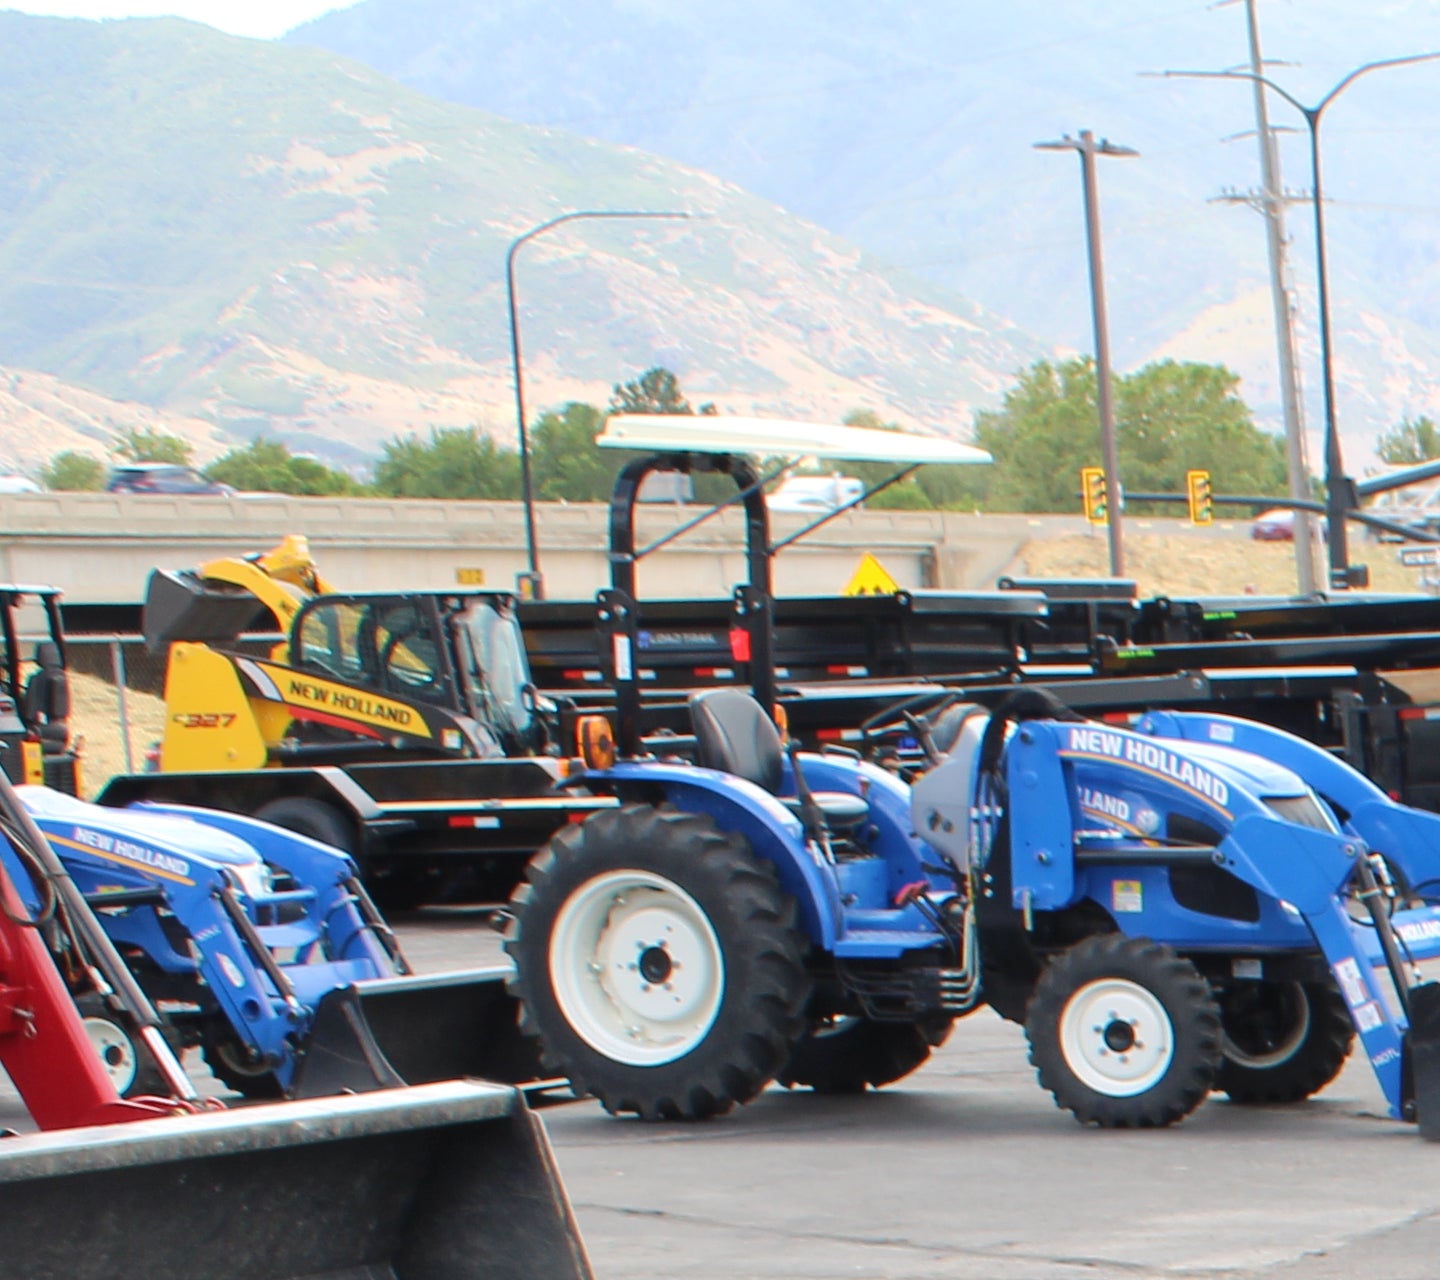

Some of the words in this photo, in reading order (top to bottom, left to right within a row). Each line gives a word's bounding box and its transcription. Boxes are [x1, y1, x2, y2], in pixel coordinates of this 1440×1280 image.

[289, 680, 331, 704] NEW
[331, 692, 411, 726] HOLLAND
[1070, 728, 1123, 757] NEW
[1126, 738, 1229, 807] HOLLAND
[73, 826, 114, 851] NEW
[113, 838, 190, 877] HOLLAND
